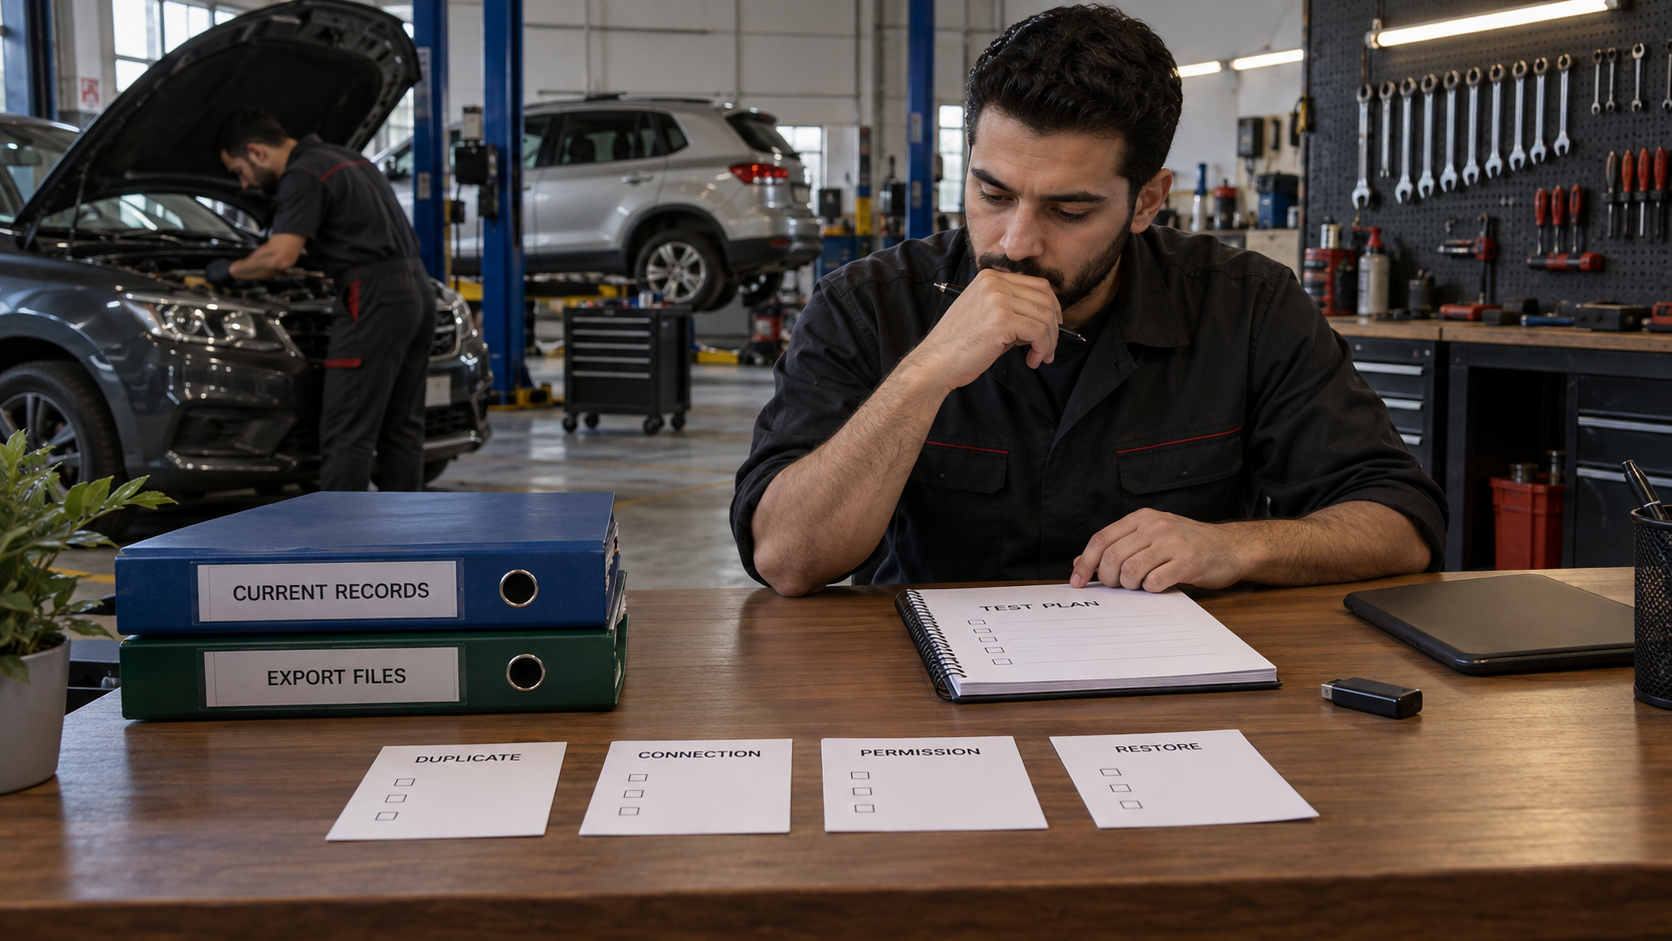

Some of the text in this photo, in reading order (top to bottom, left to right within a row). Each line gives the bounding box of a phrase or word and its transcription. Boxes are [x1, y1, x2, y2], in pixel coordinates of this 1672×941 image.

[233, 582, 430, 602] CURRENT RECORDS
[979, 600, 1100, 612] TEST PLAN
[267, 667, 407, 687] EXPORT FILES
[860, 747, 981, 757] PERMISSION
[1114, 742, 1203, 754] RESTORE
[414, 753, 522, 764] DUPLICATE
[638, 750, 761, 760] CONNECTION
